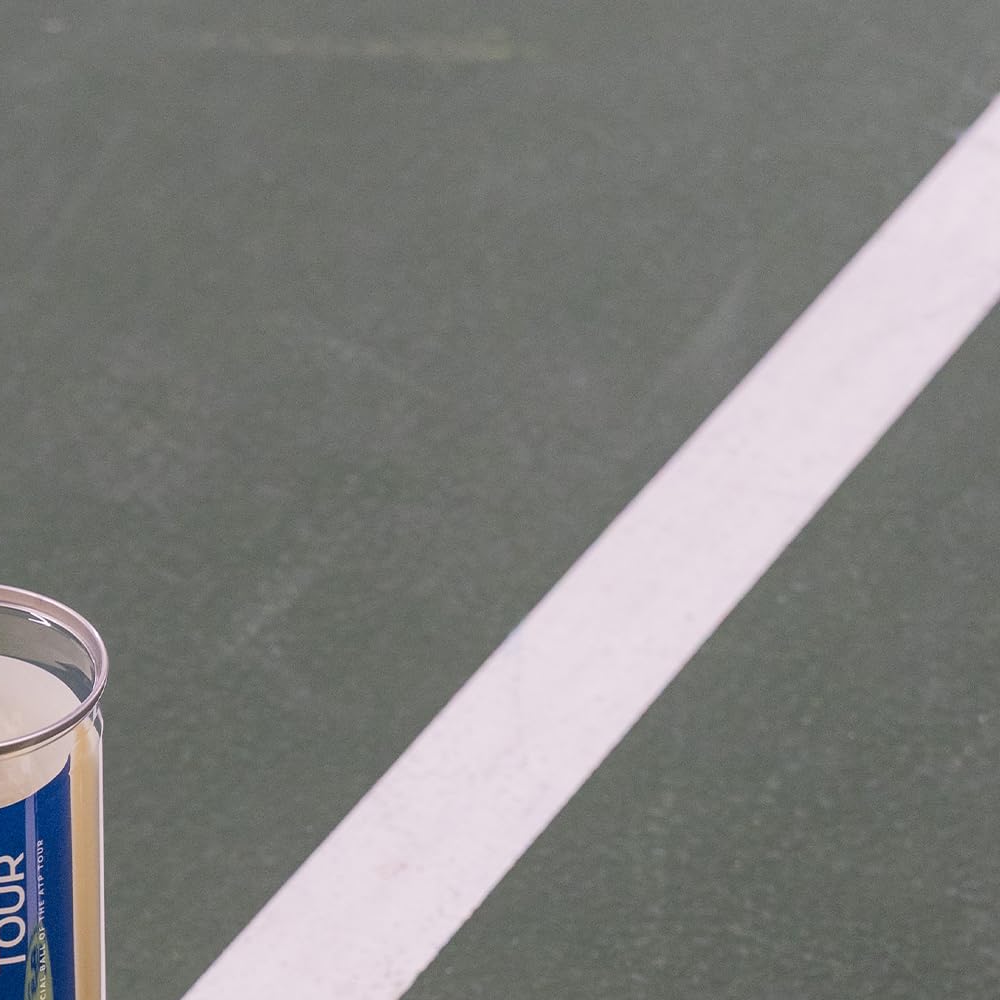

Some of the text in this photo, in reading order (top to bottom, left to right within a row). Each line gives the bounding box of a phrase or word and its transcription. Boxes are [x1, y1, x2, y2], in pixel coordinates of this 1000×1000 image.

[36, 839, 44, 871] TOUR
[37, 874, 45, 896] ATP
[38, 926, 46, 940] OF
